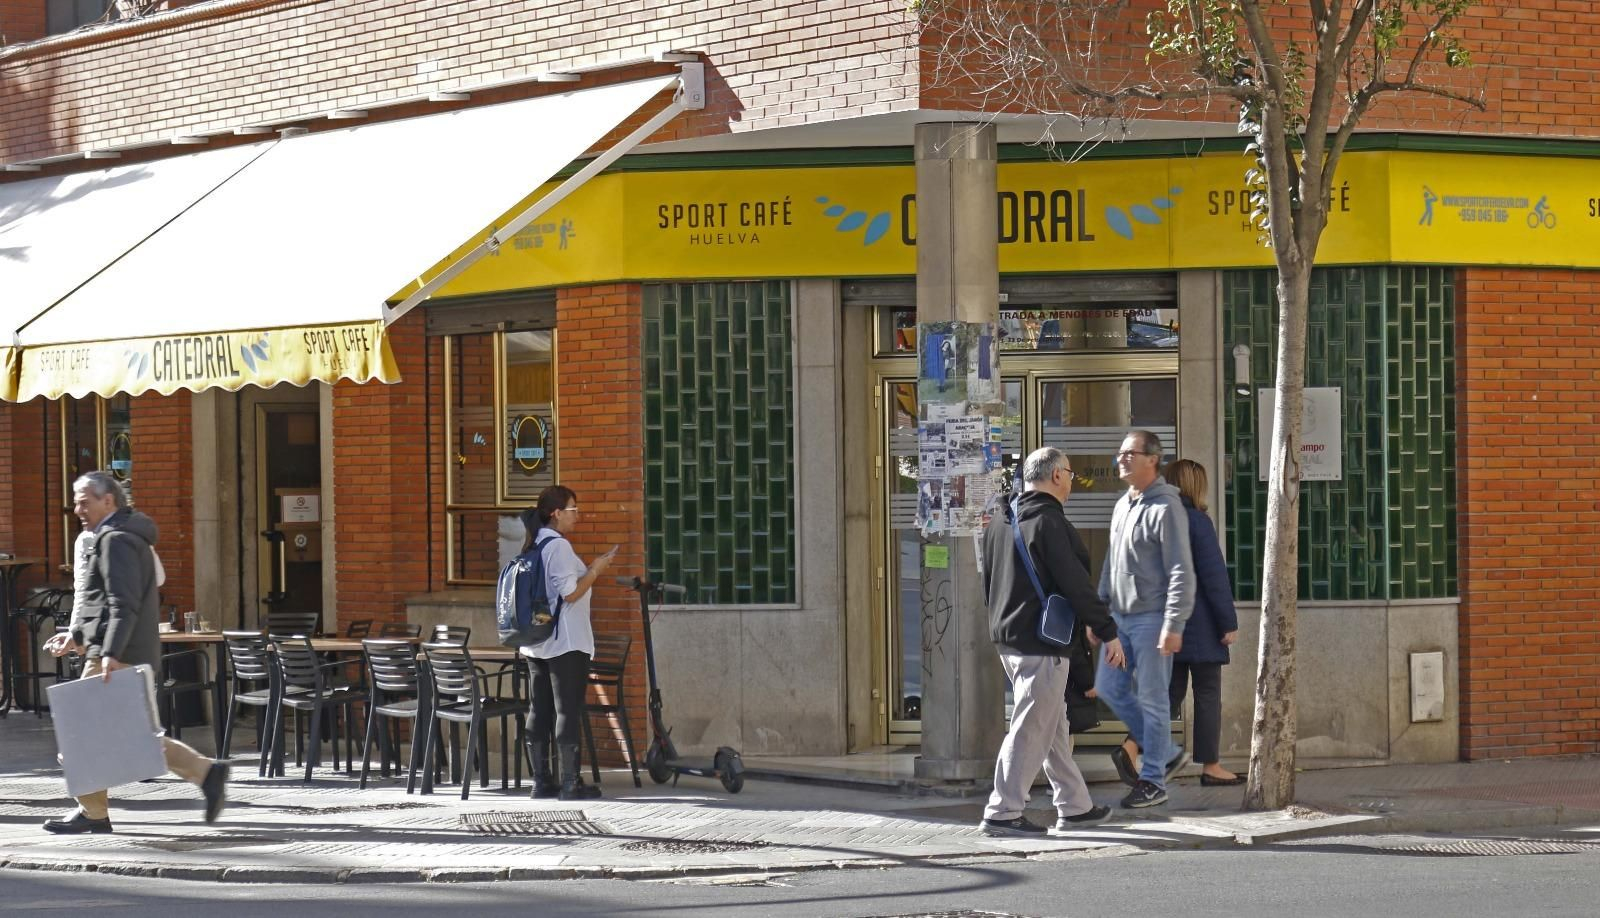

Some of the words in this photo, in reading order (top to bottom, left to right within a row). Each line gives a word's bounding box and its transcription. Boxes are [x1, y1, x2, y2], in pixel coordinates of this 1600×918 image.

[658, 203, 728, 229] SPORT
[740, 195, 793, 227] CAFÉ
[902, 189, 1096, 246] CDRAL
[690, 233, 760, 245] HUELVA
[999, 310, 1036, 320] TRADA
[1105, 310, 1120, 318] DE
[303, 329, 339, 355] SPORT
[153, 334, 240, 382] CATEDRAL
